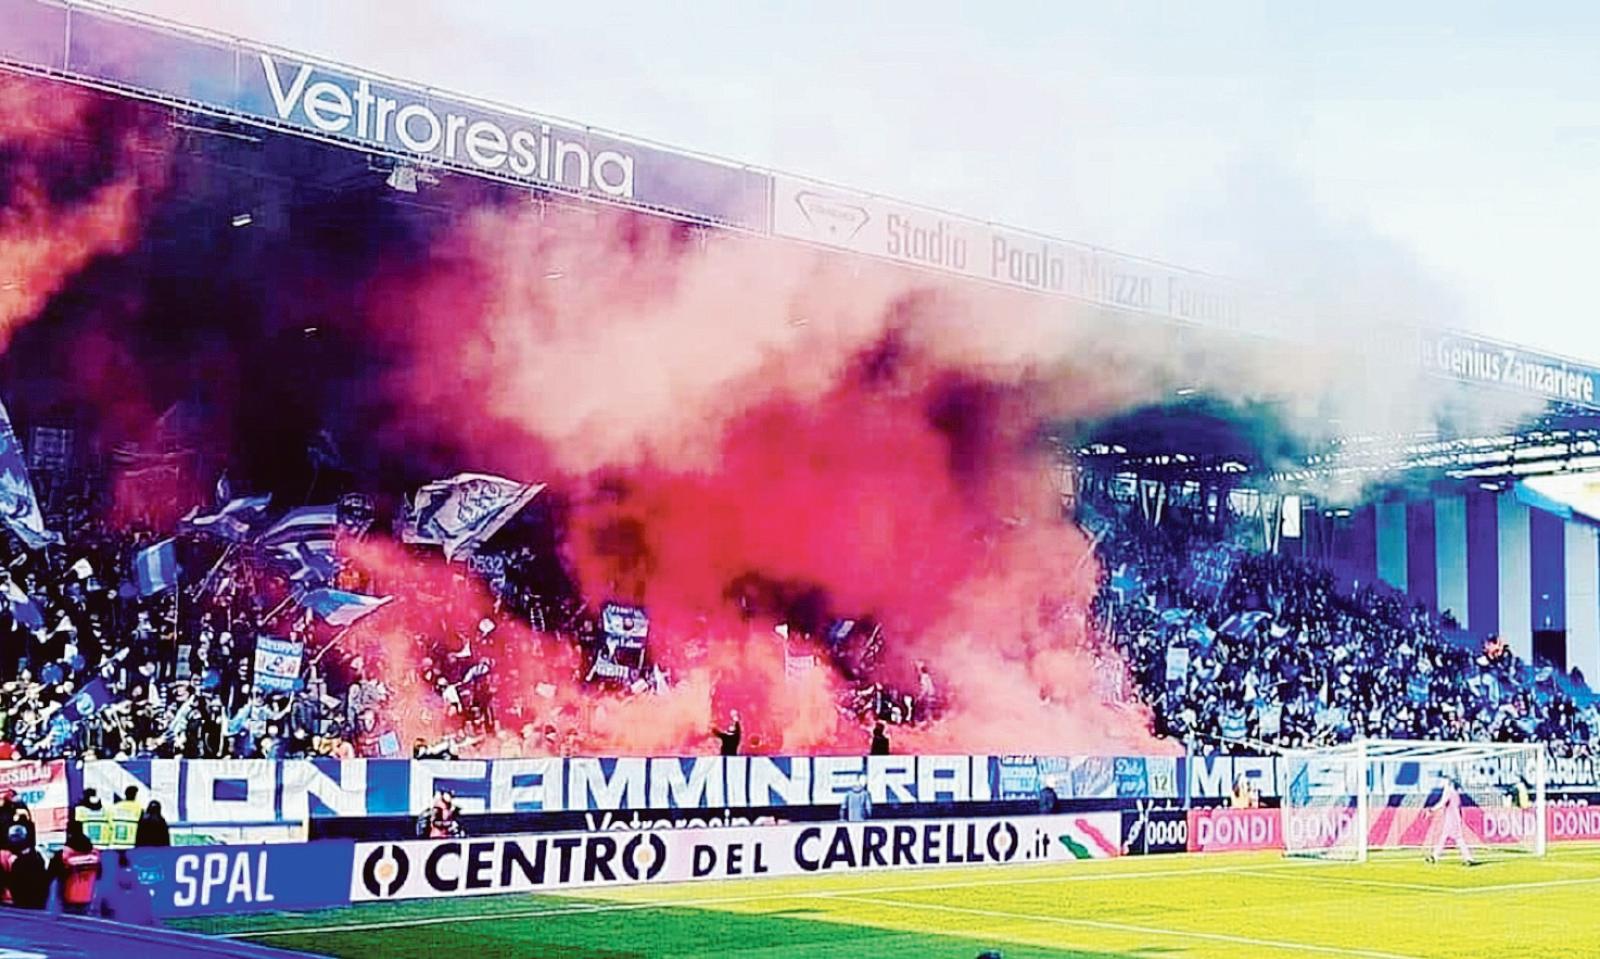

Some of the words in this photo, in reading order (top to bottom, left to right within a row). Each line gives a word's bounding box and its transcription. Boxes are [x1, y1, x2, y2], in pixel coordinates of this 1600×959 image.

[260, 53, 635, 199] Vetroresina
[1437, 336, 1501, 382] Genius
[1501, 351, 1594, 402] Zanzariere
[1153, 775, 1169, 792] 12
[1523, 757, 1594, 786] GARDIA
[83, 757, 369, 826] NON
[411, 756, 990, 817] CAMMINERAI
[1197, 815, 1275, 847] DONDI
[1291, 814, 1355, 846] DOND
[1484, 809, 1537, 838] DOND
[1553, 810, 1600, 837] DOND
[173, 850, 275, 907] SPAL
[424, 833, 667, 893] CENTRO
[692, 843, 768, 877] DEL
